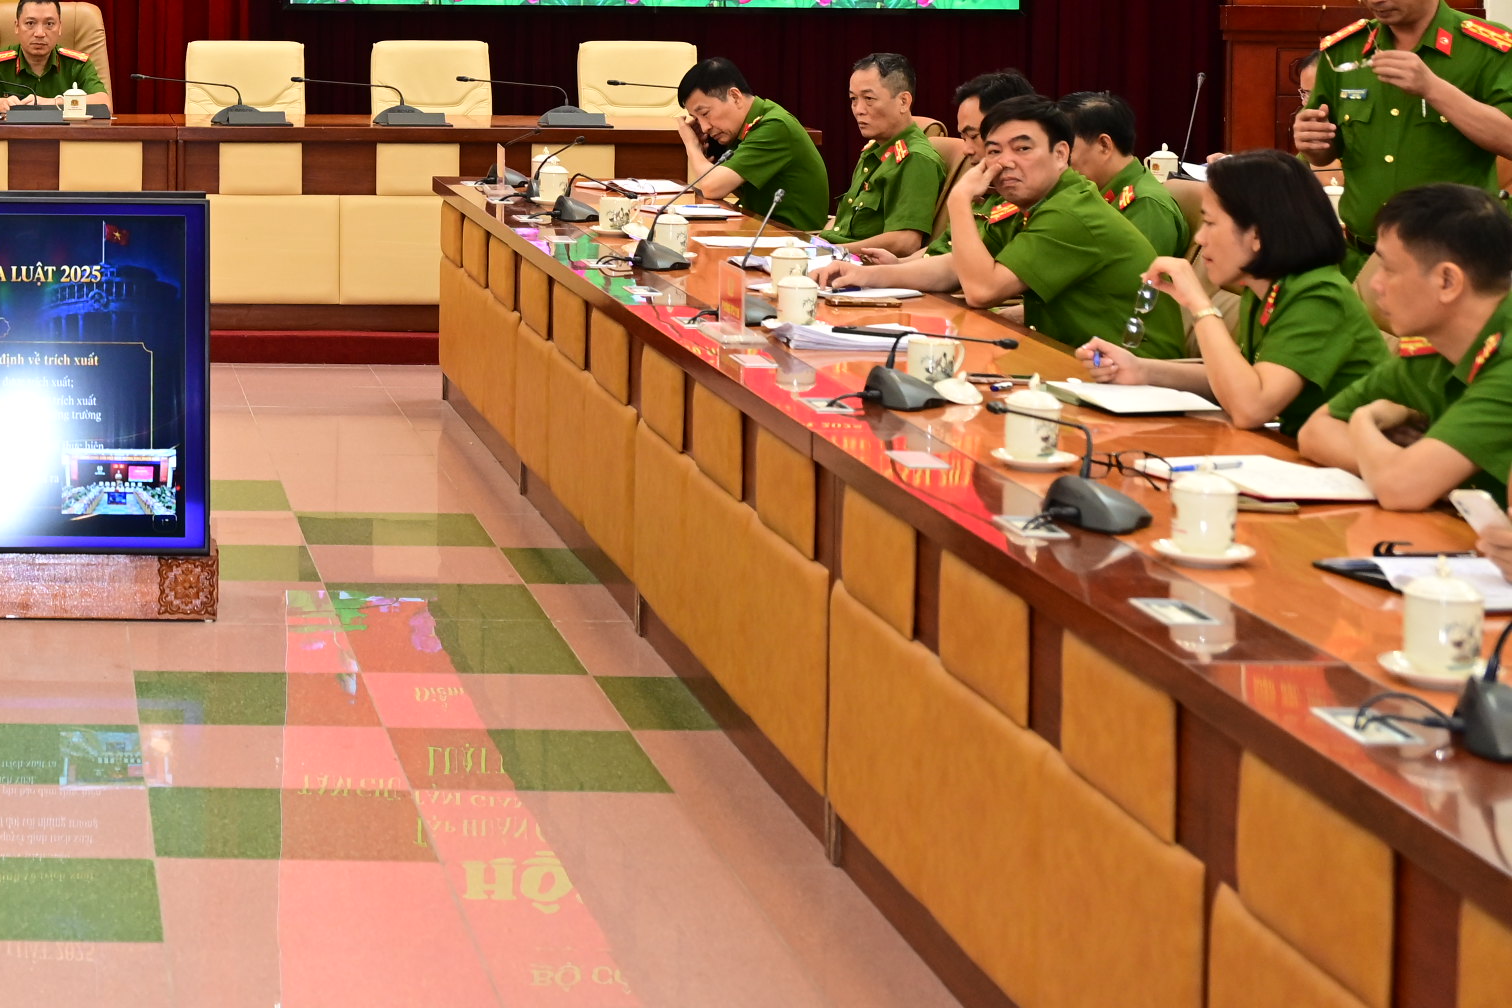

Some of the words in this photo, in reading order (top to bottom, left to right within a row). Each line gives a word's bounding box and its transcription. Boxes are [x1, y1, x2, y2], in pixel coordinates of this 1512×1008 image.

[10, 262, 56, 286] LUẬT
[61, 265, 102, 283] 2025
[0, 353, 24, 367] định
[28, 352, 41, 365] về
[44, 353, 70, 365] trích
[75, 352, 98, 366] xuất
